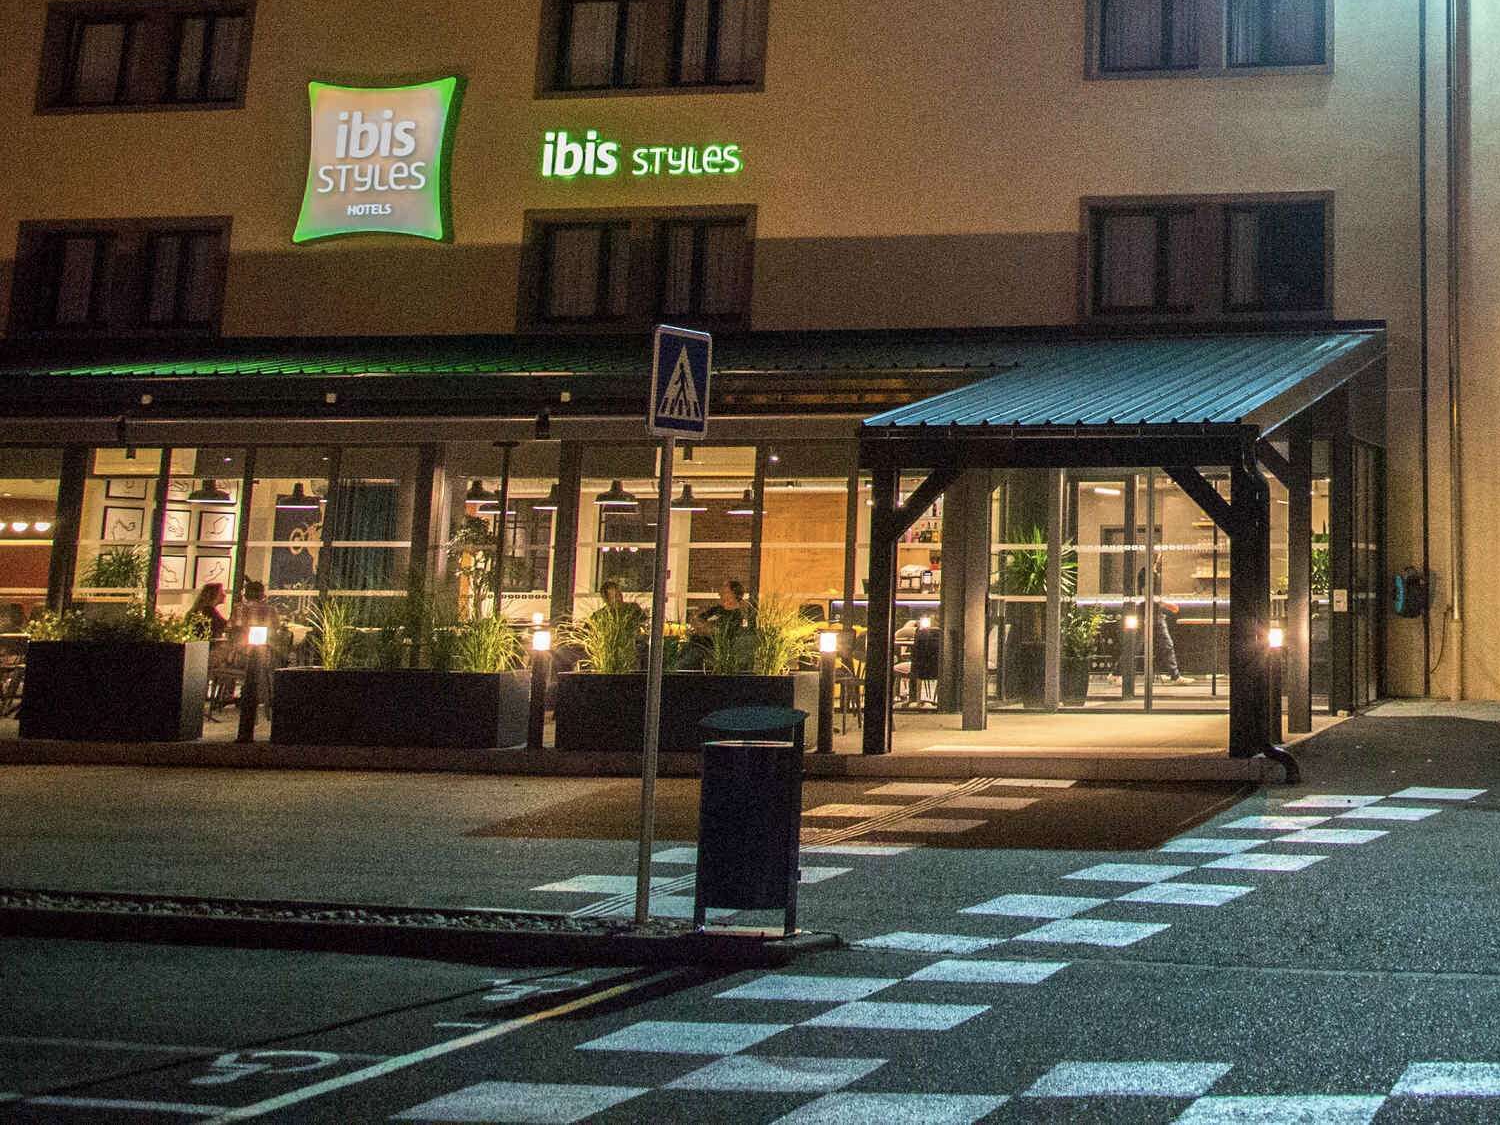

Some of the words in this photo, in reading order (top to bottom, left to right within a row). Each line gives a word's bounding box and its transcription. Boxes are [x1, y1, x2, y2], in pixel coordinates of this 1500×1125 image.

[336, 111, 416, 158] ibis
[542, 130, 618, 176] ibis
[347, 203, 392, 216] HOTELS
